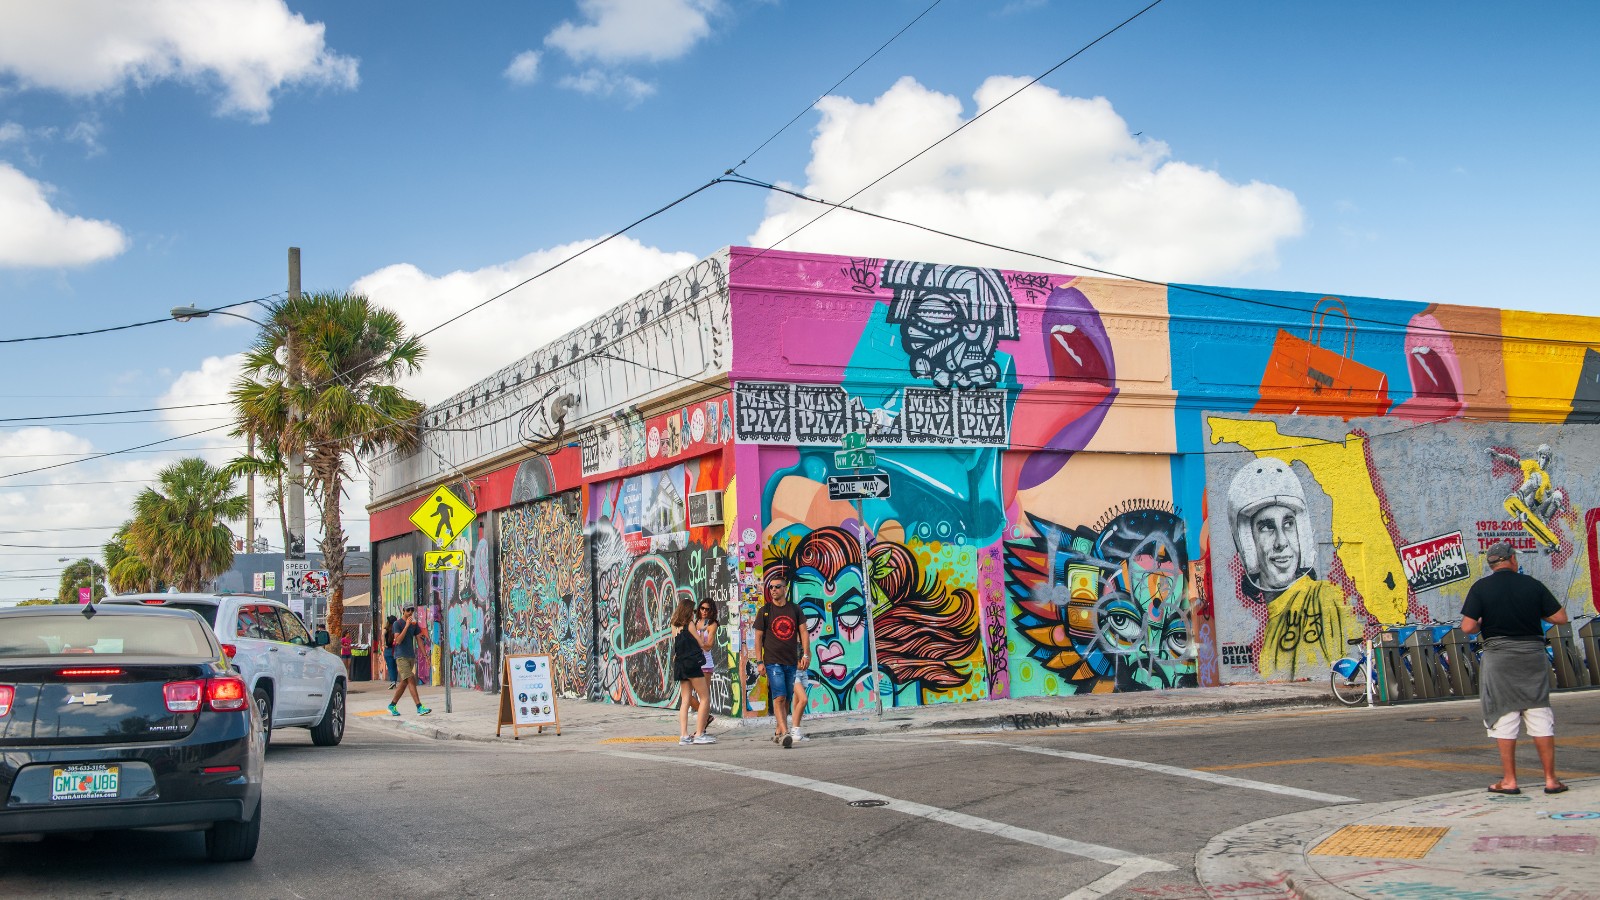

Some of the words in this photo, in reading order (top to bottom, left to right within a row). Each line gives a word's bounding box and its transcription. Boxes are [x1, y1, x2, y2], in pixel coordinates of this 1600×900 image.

[740, 389, 786, 409] MAS
[798, 392, 842, 411] MAS
[908, 395, 950, 414] MAS
[960, 396, 1001, 414] MAS
[740, 409, 788, 433] PAZ
[799, 411, 845, 434] PAZ
[909, 414, 951, 436] PAZ
[961, 414, 1002, 436] PAZ
[837, 456, 847, 467] NW
[851, 453, 864, 467] 24
[869, 455, 875, 465] ST
[840, 482, 856, 493] ONE
[863, 481, 879, 491] WAY
[1476, 521, 1523, 531] 1978-2018
[1439, 564, 1462, 580] USA
[1222, 646, 1253, 655] BRYAN
[1223, 655, 1254, 665] DEESE
